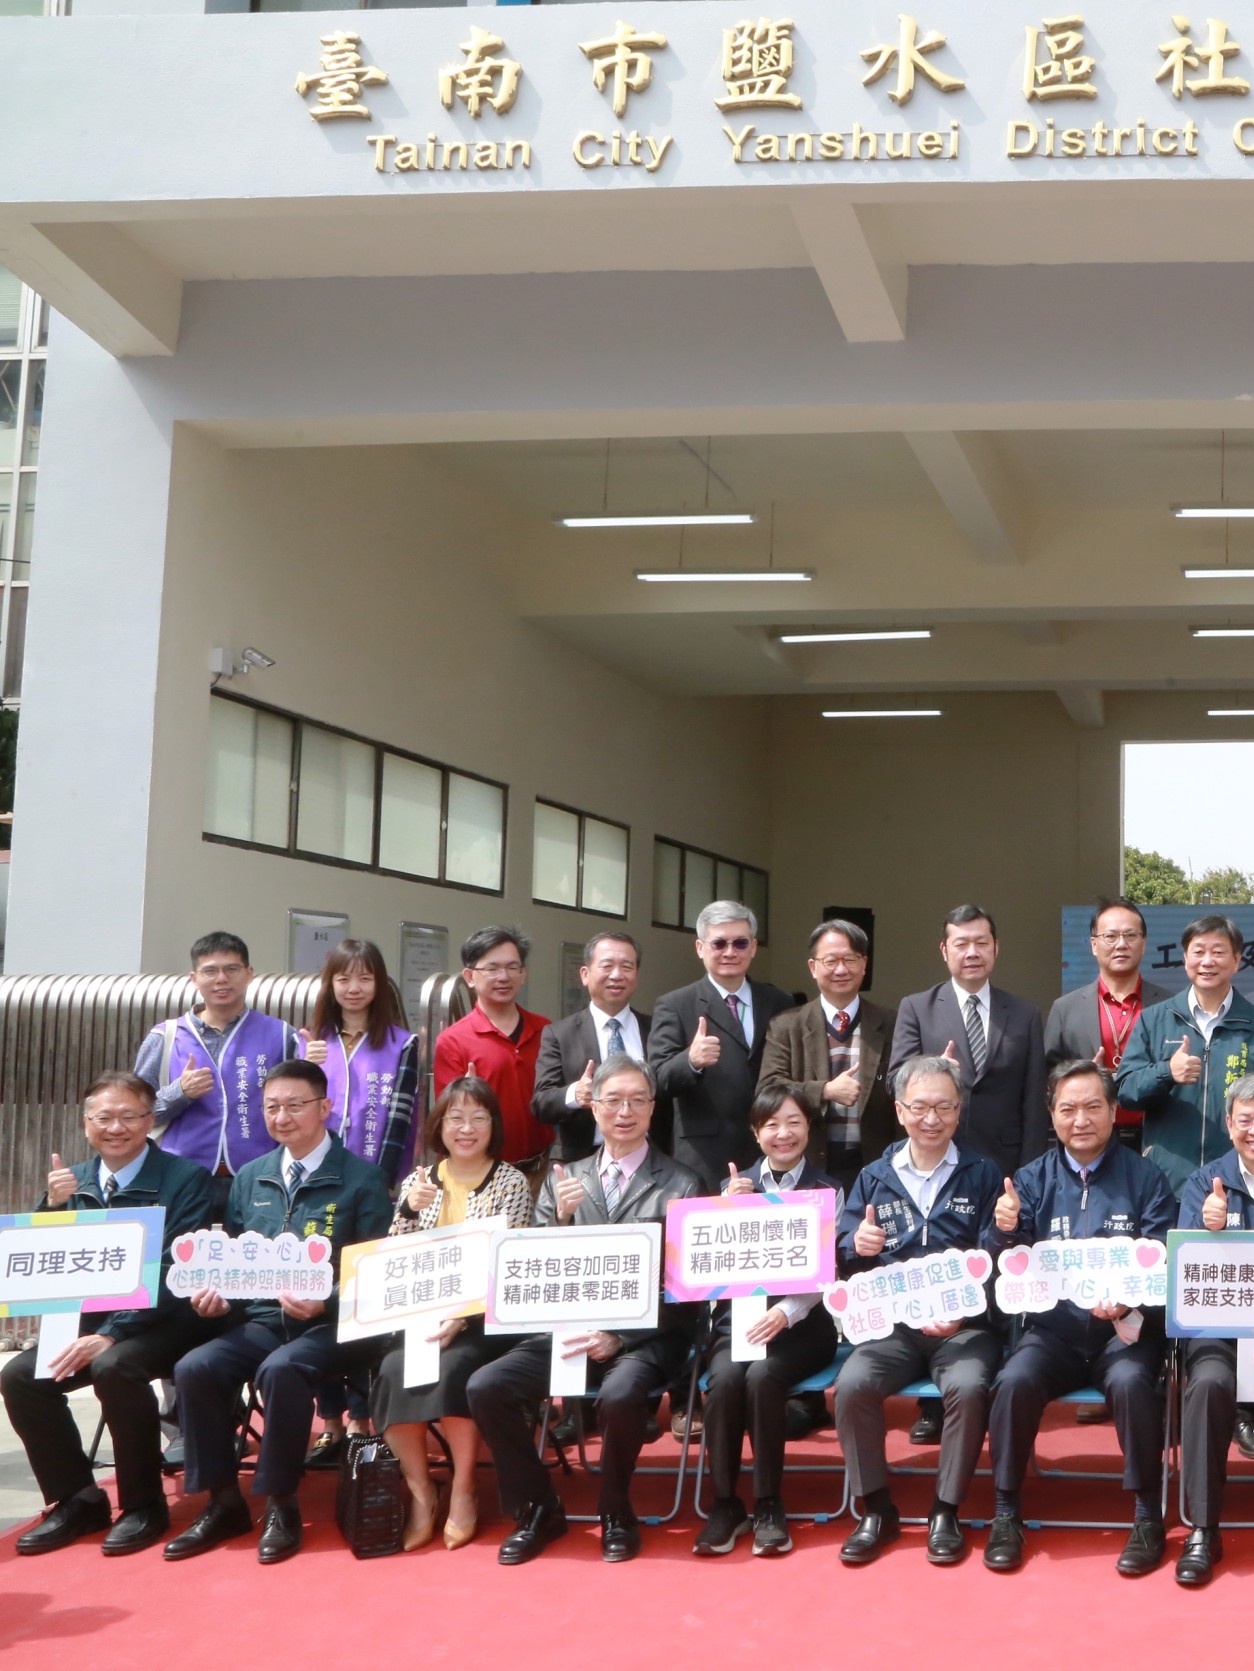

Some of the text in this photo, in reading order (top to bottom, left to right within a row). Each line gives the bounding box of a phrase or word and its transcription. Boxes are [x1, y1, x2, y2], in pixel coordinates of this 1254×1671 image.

[366, 133, 532, 174] Tainan
[572, 130, 673, 173] City
[722, 119, 960, 165] Yanshuei
[1007, 117, 1198, 159] District
[691, 1217, 809, 1247] 五心關懷情
[1226, 1212, 1240, 1227] 陳
[6, 1246, 127, 1279] 同理支持
[384, 1244, 462, 1281] 好精神
[505, 1254, 641, 1280] 支持包容加同理
[690, 1245, 808, 1275] 精神去污名
[1038, 1245, 1130, 1273] 愛與專業
[1183, 1262, 1254, 1284] 精神健康
[172, 1268, 326, 1292] 心理及精神照護服務
[503, 1278, 640, 1306] 精神健康零距離
[852, 1258, 963, 1302] 心理健康促進
[1183, 1287, 1254, 1308] 家庭支持
